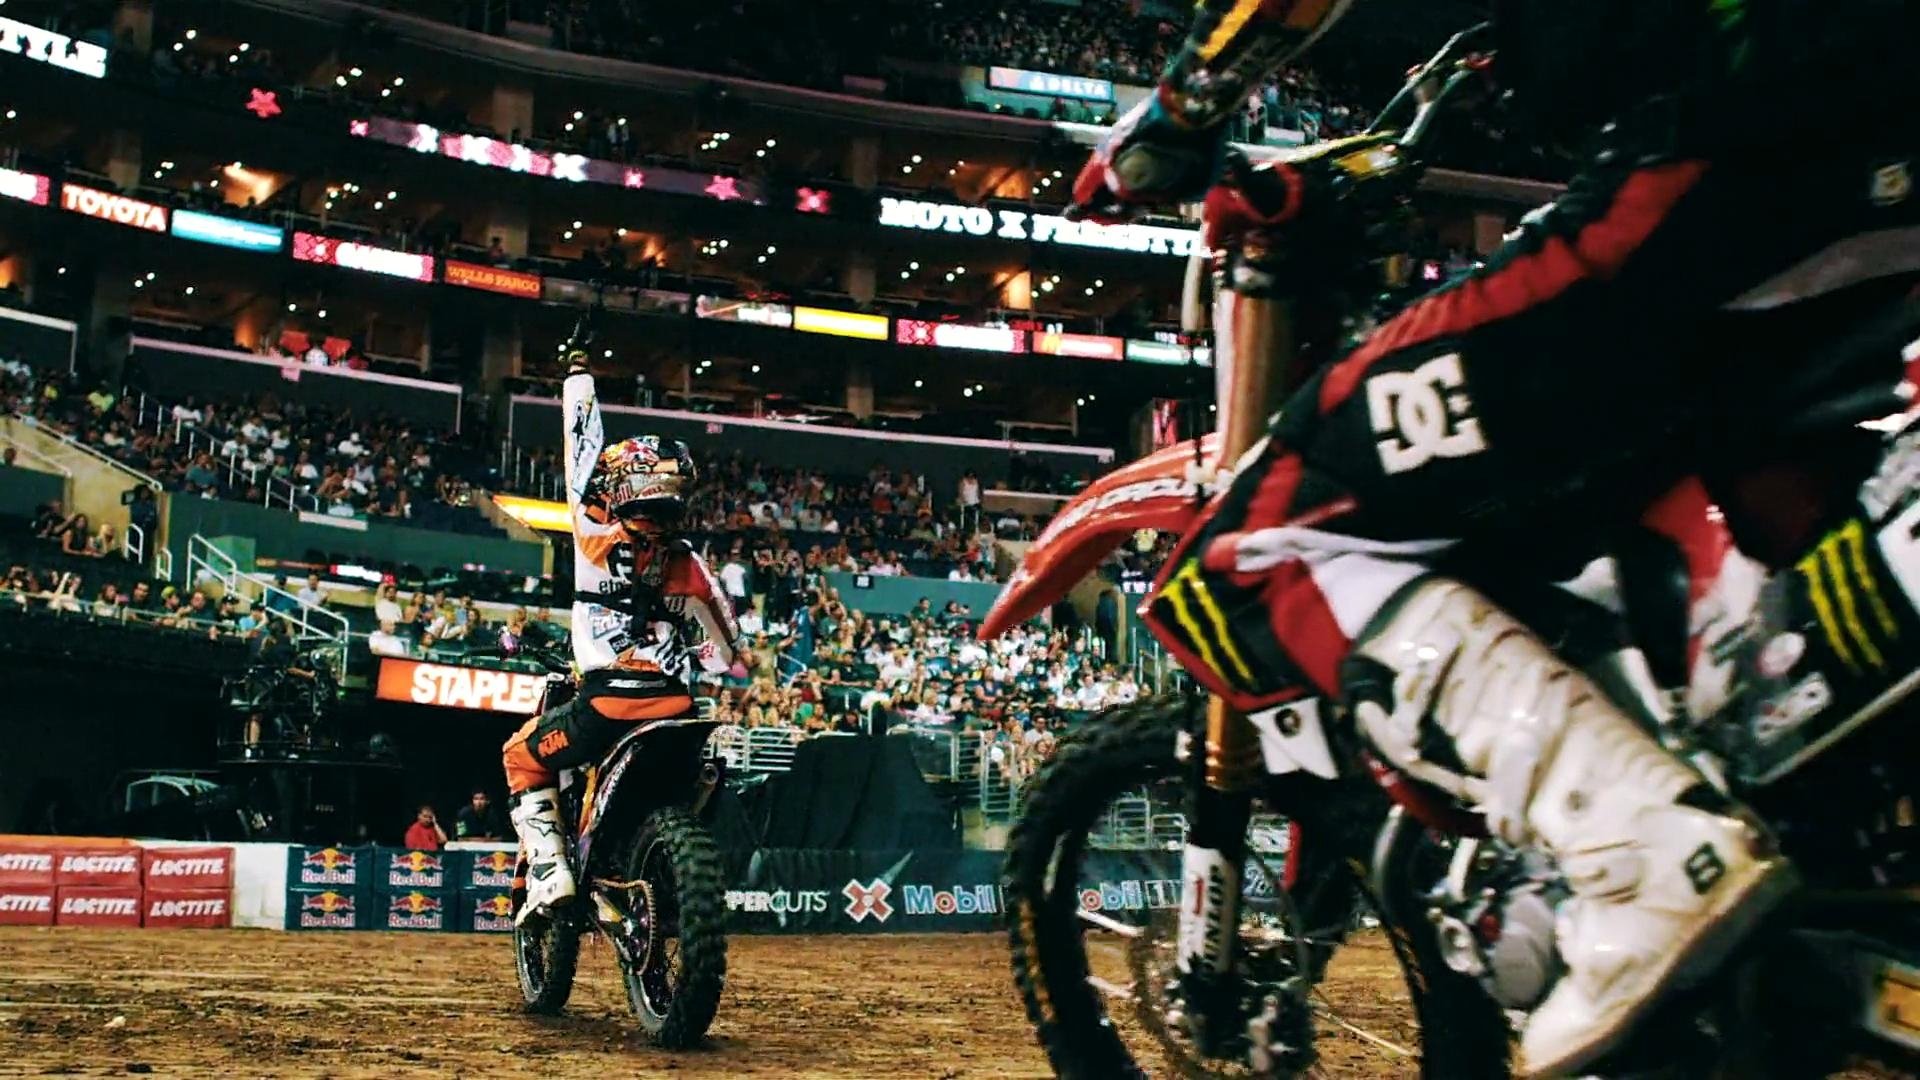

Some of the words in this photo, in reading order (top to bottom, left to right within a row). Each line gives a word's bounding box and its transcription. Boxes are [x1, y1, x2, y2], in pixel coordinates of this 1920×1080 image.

[63, 184, 167, 233] TOYOTA
[879, 198, 993, 236] MOTO
[997, 210, 1028, 240] X
[448, 265, 495, 285] WELLS
[496, 275, 540, 292] FARGO
[1366, 353, 1487, 475] DC
[302, 868, 329, 883] Red
[330, 868, 356, 884] Bull
[389, 871, 416, 885] Red
[417, 872, 442, 887] Bull
[903, 884, 997, 914] Mobil
[1078, 880, 1143, 911] obil
[301, 911, 329, 927] Red
[330, 911, 356, 928] Bull
[388, 912, 415, 927] Red
[416, 912, 442, 928] Bull
